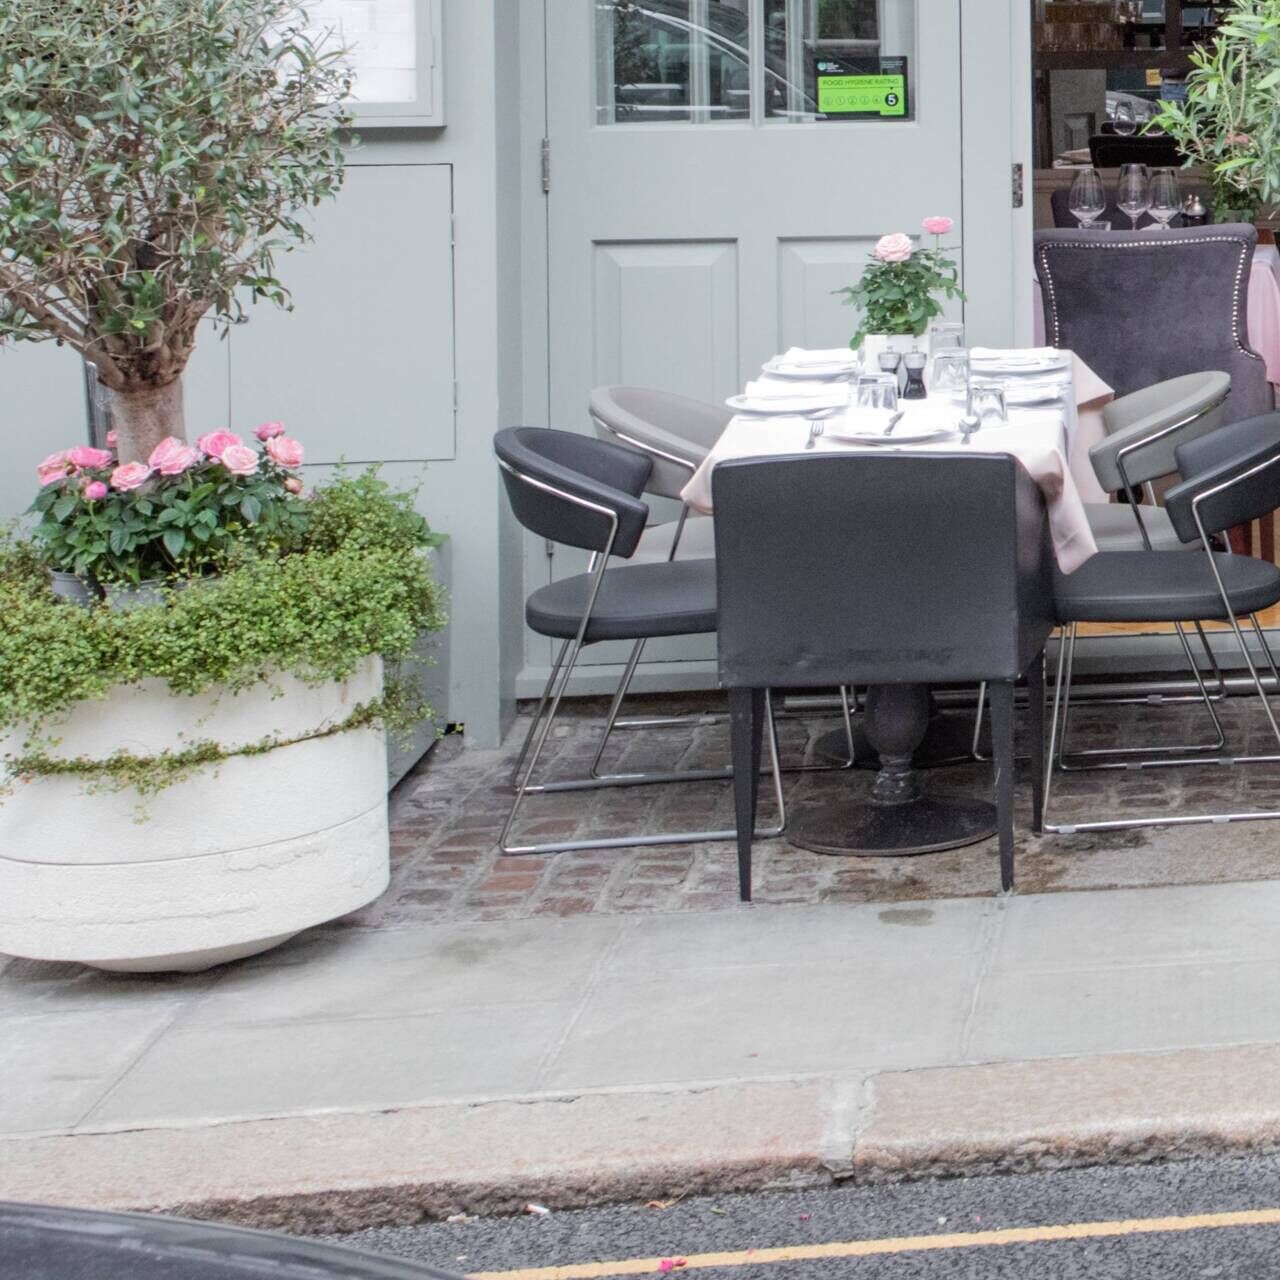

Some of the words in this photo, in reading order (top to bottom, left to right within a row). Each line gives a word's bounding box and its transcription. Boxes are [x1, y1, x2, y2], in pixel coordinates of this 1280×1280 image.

[845, 78, 873, 86] HYGIENE
[875, 77, 899, 85] RATING
[887, 95, 895, 105] 5
